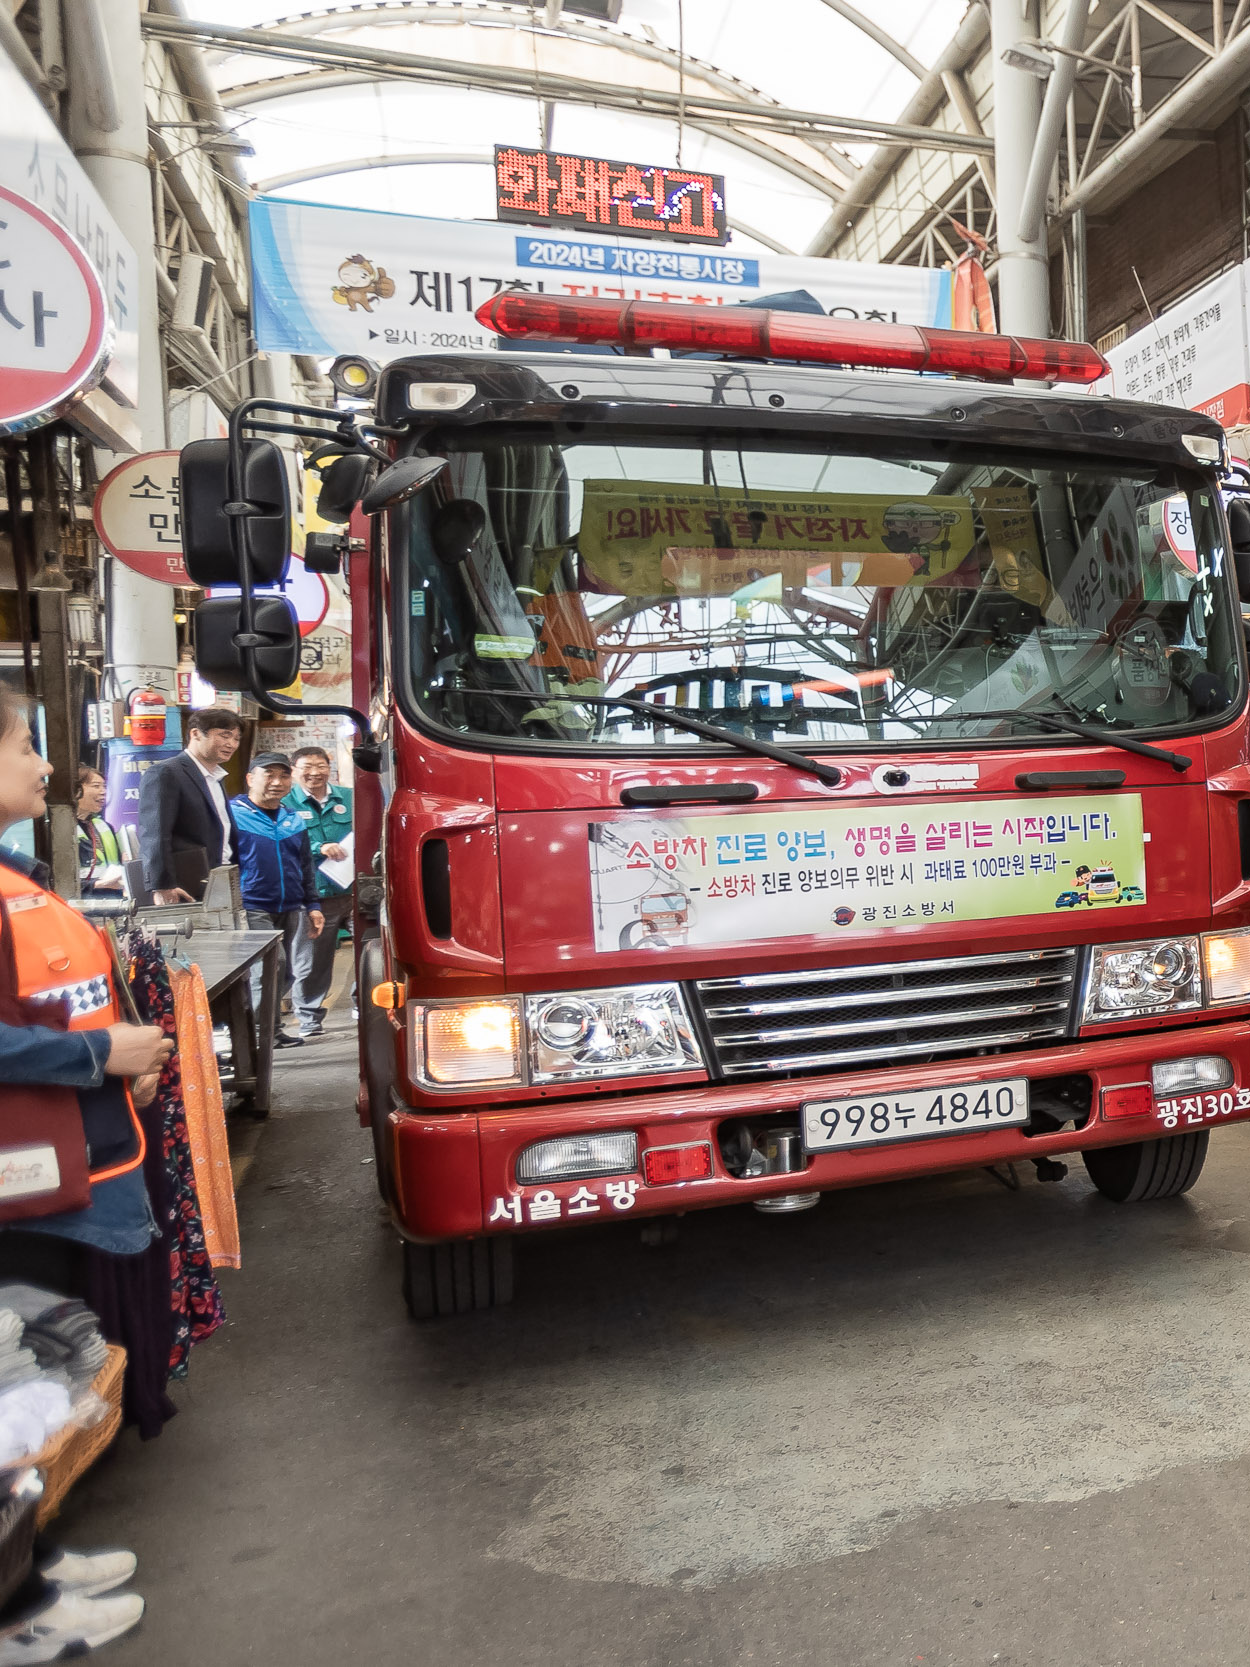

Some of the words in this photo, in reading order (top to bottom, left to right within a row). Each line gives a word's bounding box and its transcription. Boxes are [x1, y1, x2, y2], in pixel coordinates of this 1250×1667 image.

[497, 148, 719, 237] 화재신고
[528, 241, 605, 272] 2024년
[611, 248, 746, 285] 자양전통시장
[384, 329, 417, 346] 일시
[430, 332, 485, 349] 2024년
[626, 836, 708, 871] 소방차
[716, 833, 768, 867] 진로
[777, 829, 836, 862] 양보,
[845, 822, 917, 858] 생명을
[925, 820, 993, 852] 살리는
[1002, 812, 1118, 846] 시작입니다.
[707, 873, 757, 899] 소방차
[761, 872, 793, 895] 진로
[798, 867, 860, 893] 양보의무
[865, 863, 895, 889] 위반
[900, 862, 914, 886] 시
[925, 859, 968, 883] 과태료
[972, 854, 1026, 878] 100만원
[1029, 852, 1057, 875] 부과
[862, 900, 955, 922] 광진소방서
[820, 1098, 917, 1137] 998누
[925, 1086, 1017, 1126] 4840
[489, 1179, 641, 1225] 서울소방
